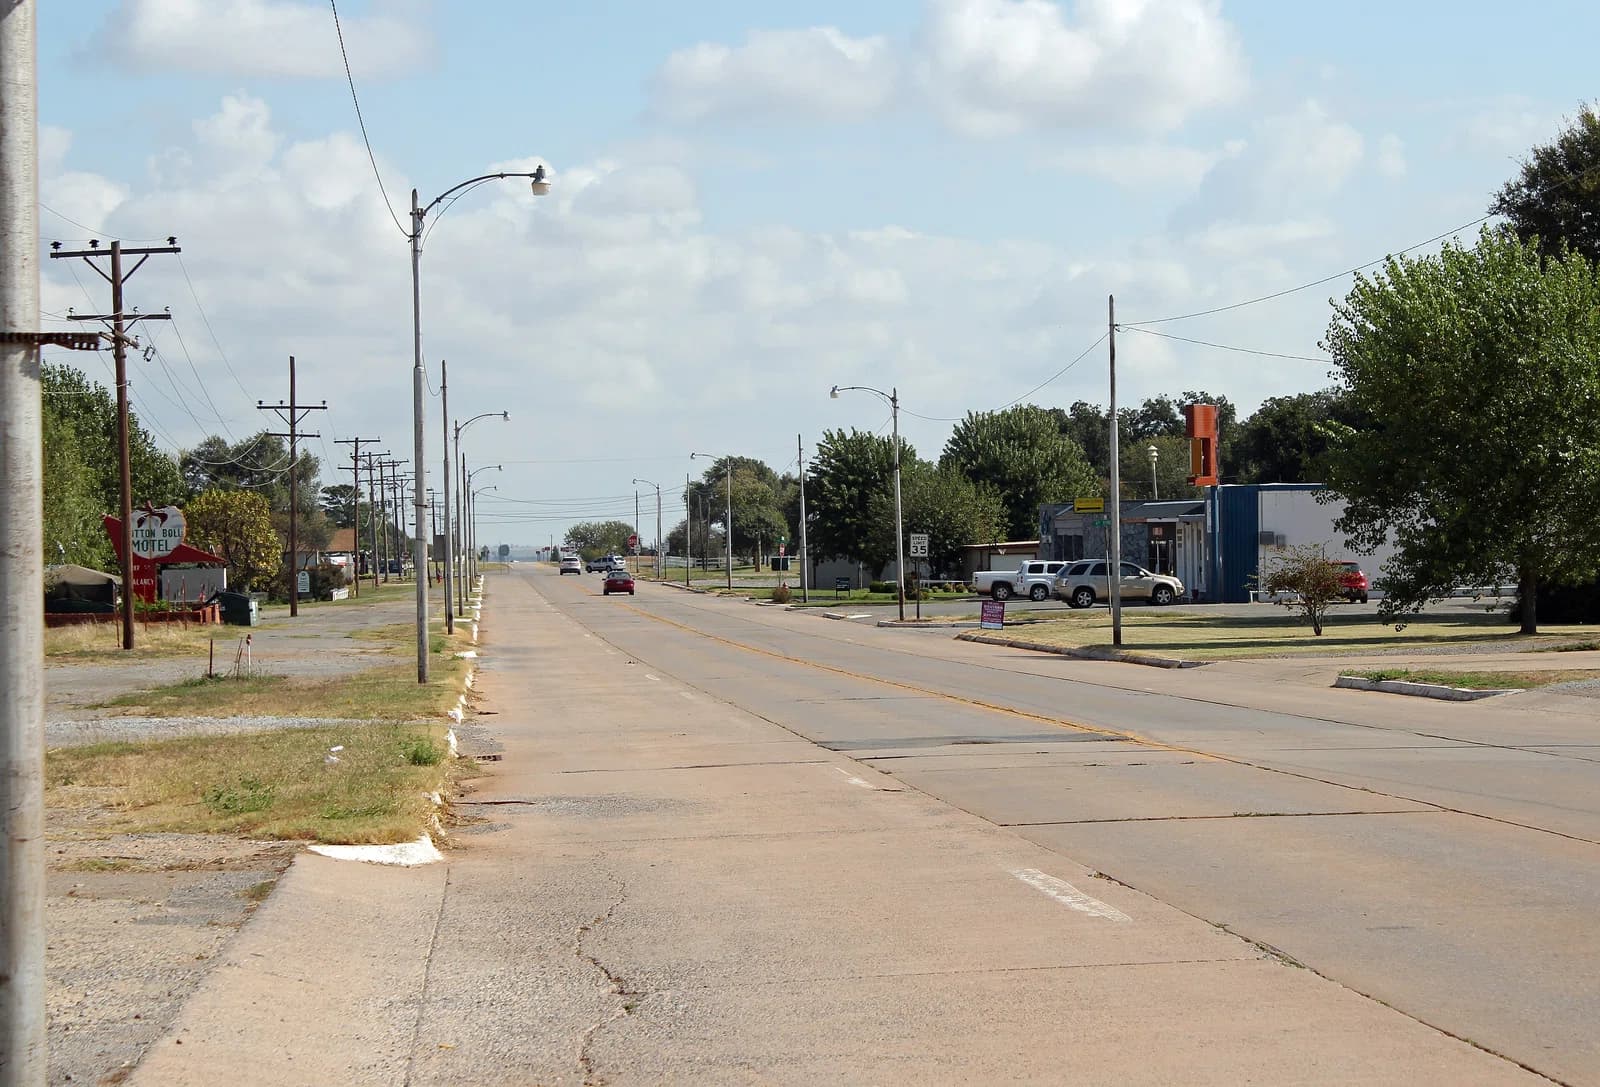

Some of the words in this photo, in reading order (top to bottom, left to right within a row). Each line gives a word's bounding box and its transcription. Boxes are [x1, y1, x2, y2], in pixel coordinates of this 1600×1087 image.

[162, 528, 183, 538] BOLL
[132, 539, 172, 552] MOTEL
[912, 545, 927, 554] 35
